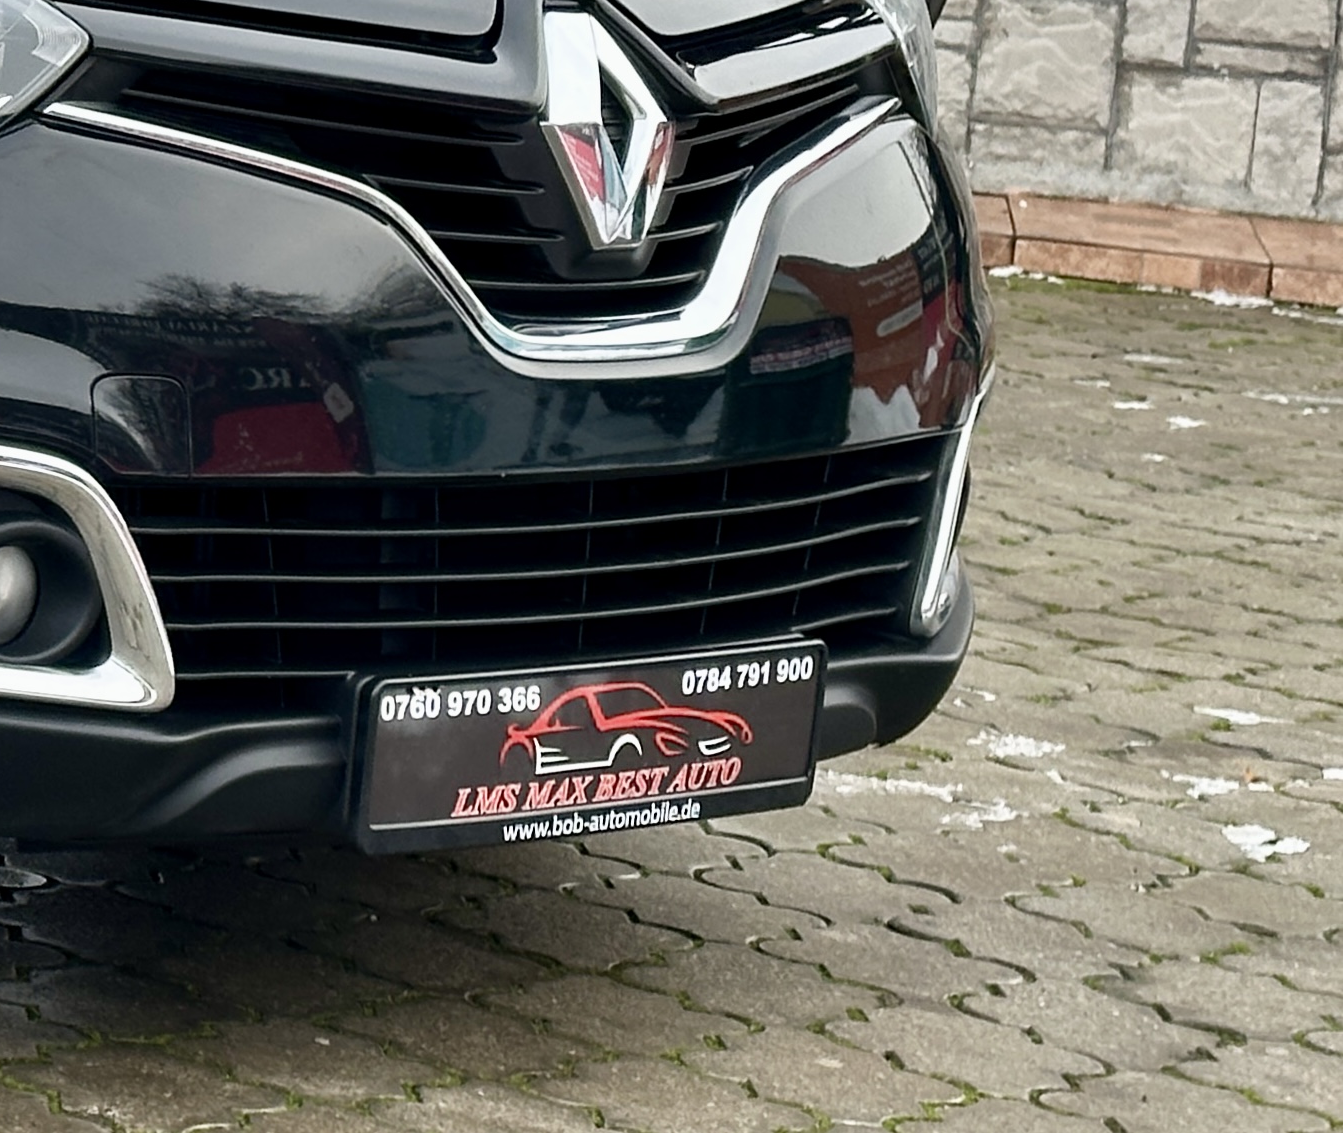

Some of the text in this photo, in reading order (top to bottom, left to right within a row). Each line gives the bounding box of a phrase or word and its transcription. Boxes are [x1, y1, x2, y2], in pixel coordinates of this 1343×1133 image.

[681, 655, 814, 695] 0784 791 900
[379, 685, 541, 722] 0760 970 366
[451, 756, 743, 818] LMS MAX BEST AUTO
[503, 798, 701, 842] www.bob-automobile.de
